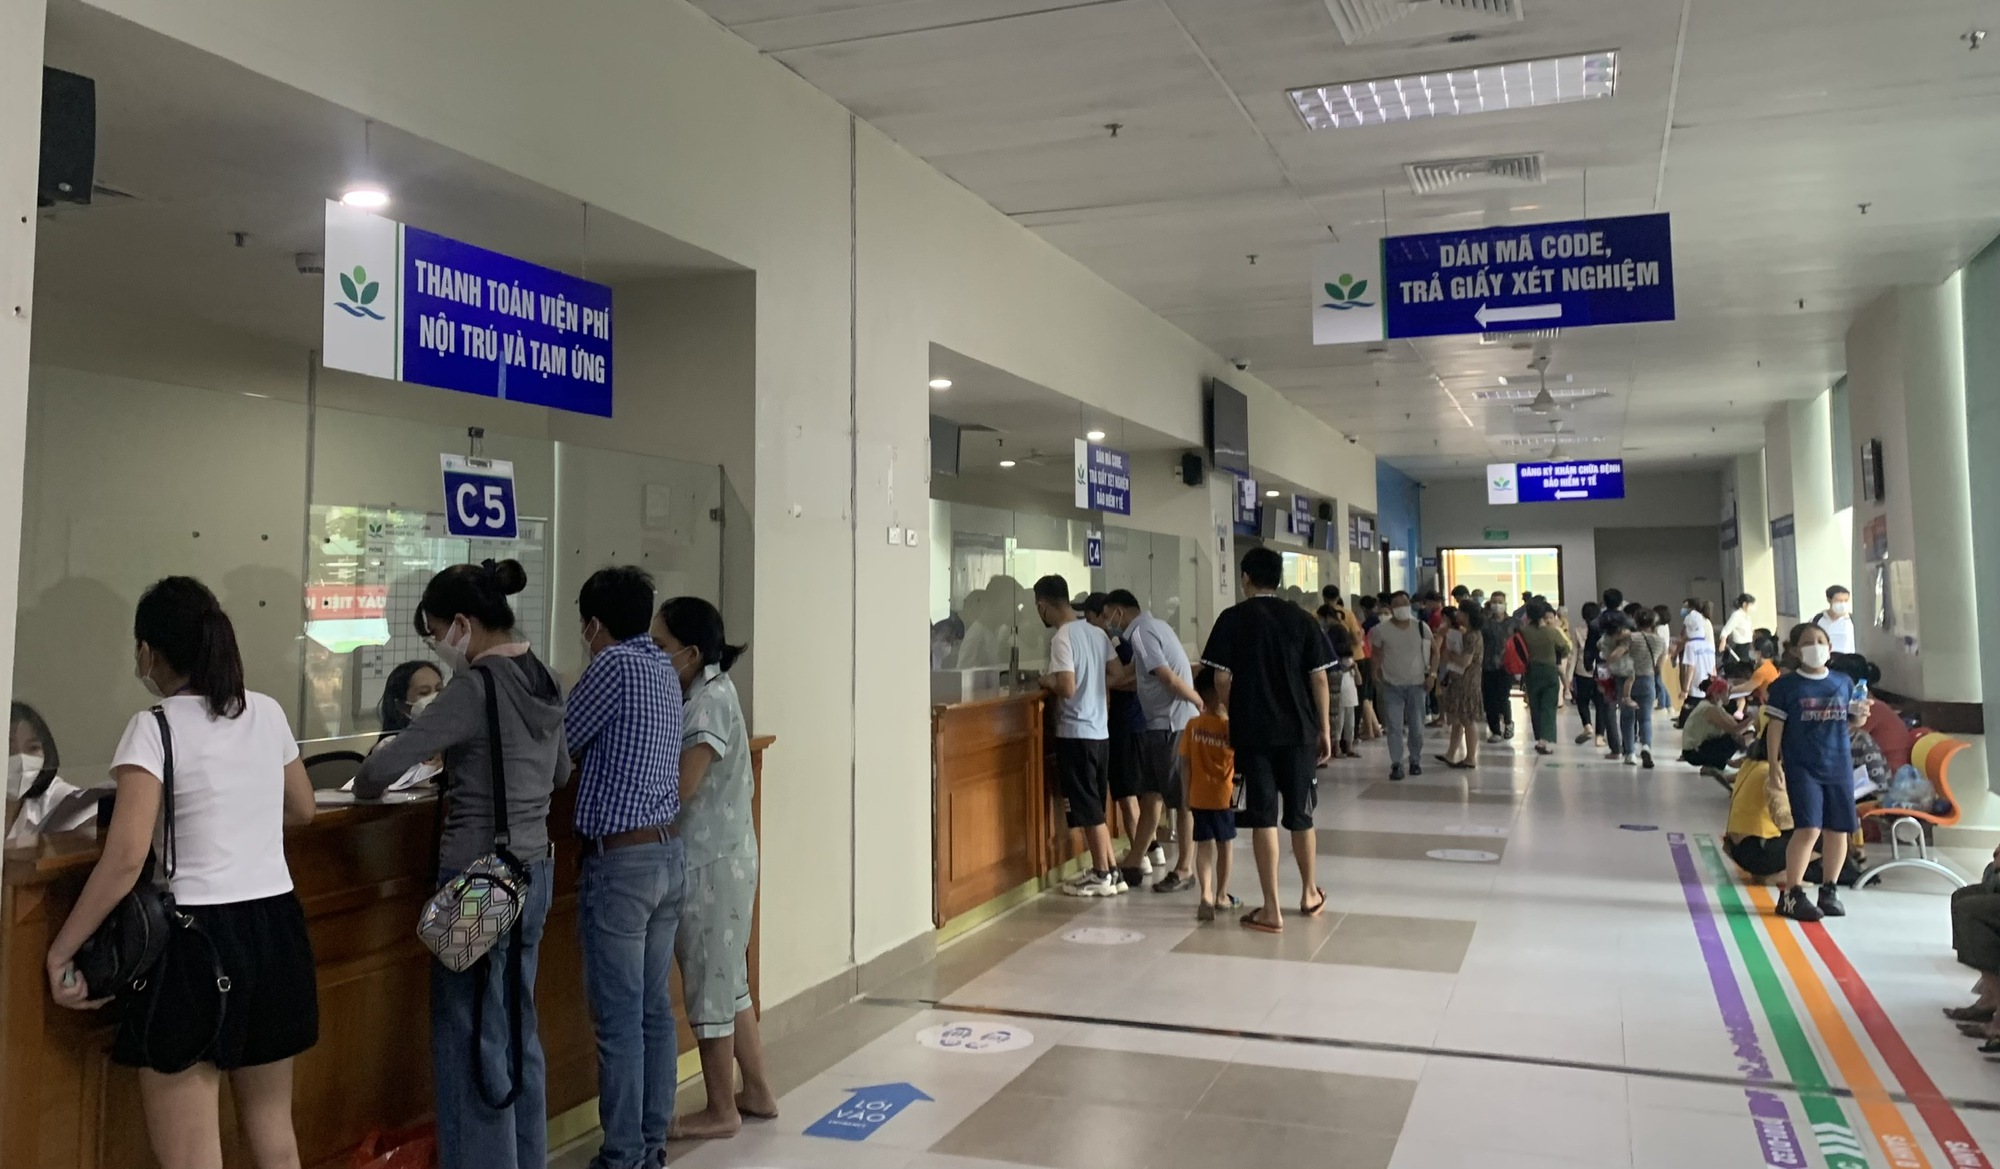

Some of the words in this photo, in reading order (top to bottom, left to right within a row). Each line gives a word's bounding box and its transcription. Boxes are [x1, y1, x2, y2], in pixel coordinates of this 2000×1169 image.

[1440, 239, 1489, 268] DÁN
[1496, 233, 1534, 263] MÃ
[1541, 231, 1612, 259] CODE,
[414, 258, 482, 308] THANH
[487, 280, 535, 321] TOÁN
[540, 293, 578, 334] VIỆN
[582, 307, 610, 341] PHÍ
[1400, 271, 1444, 304] TRẢ
[1451, 265, 1504, 300] GIẤY
[1512, 265, 1554, 295] XÉT
[1562, 258, 1660, 292] NGHIỆM
[419, 311, 455, 357] NỘI
[461, 324, 498, 361] TRÚ
[503, 330, 526, 368] VÀ
[530, 340, 566, 379] TẠM
[571, 344, 606, 384] ỨNG
[1543, 476, 1559, 488] BẢO
[1587, 474, 1597, 486] TẾ
[1554, 464, 1577, 475] KHÁM
[1578, 463, 1599, 474] CHỮA
[456, 482, 506, 529] C5
[1089, 542, 1100, 563] C4
